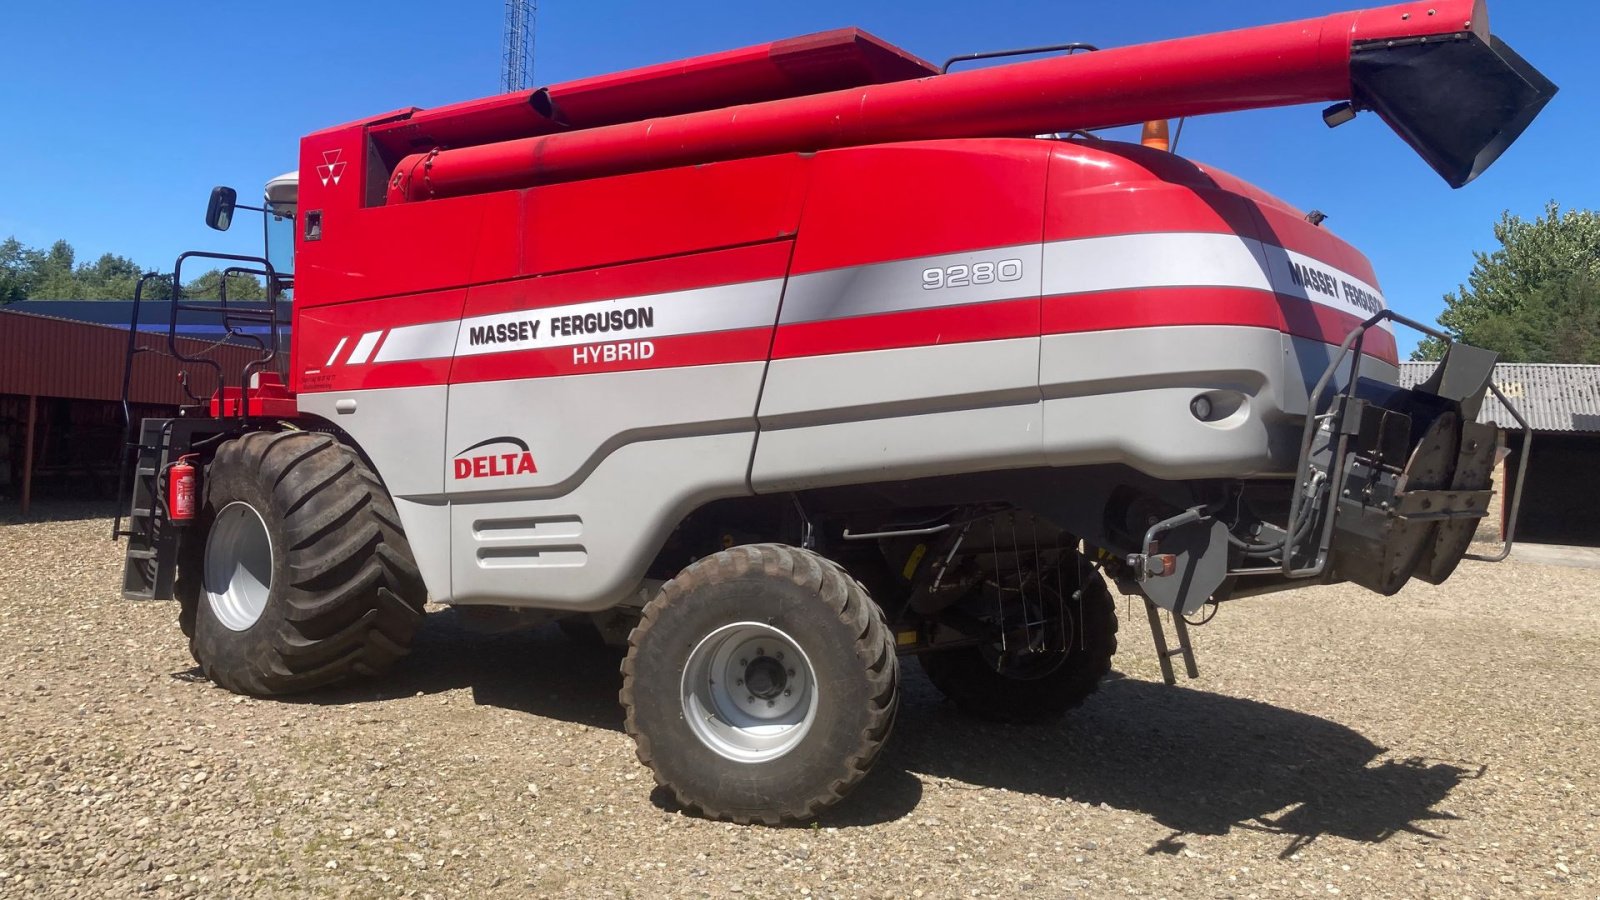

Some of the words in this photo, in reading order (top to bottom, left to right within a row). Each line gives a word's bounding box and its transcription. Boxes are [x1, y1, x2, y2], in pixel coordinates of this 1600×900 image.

[922, 258, 1023, 290] 9280
[1287, 260, 1340, 299] MASSEY
[469, 320, 541, 346] MASSEY
[550, 306, 654, 338] FERGUSON
[572, 341, 655, 365] HYBRID
[454, 452, 537, 480] DELTA
